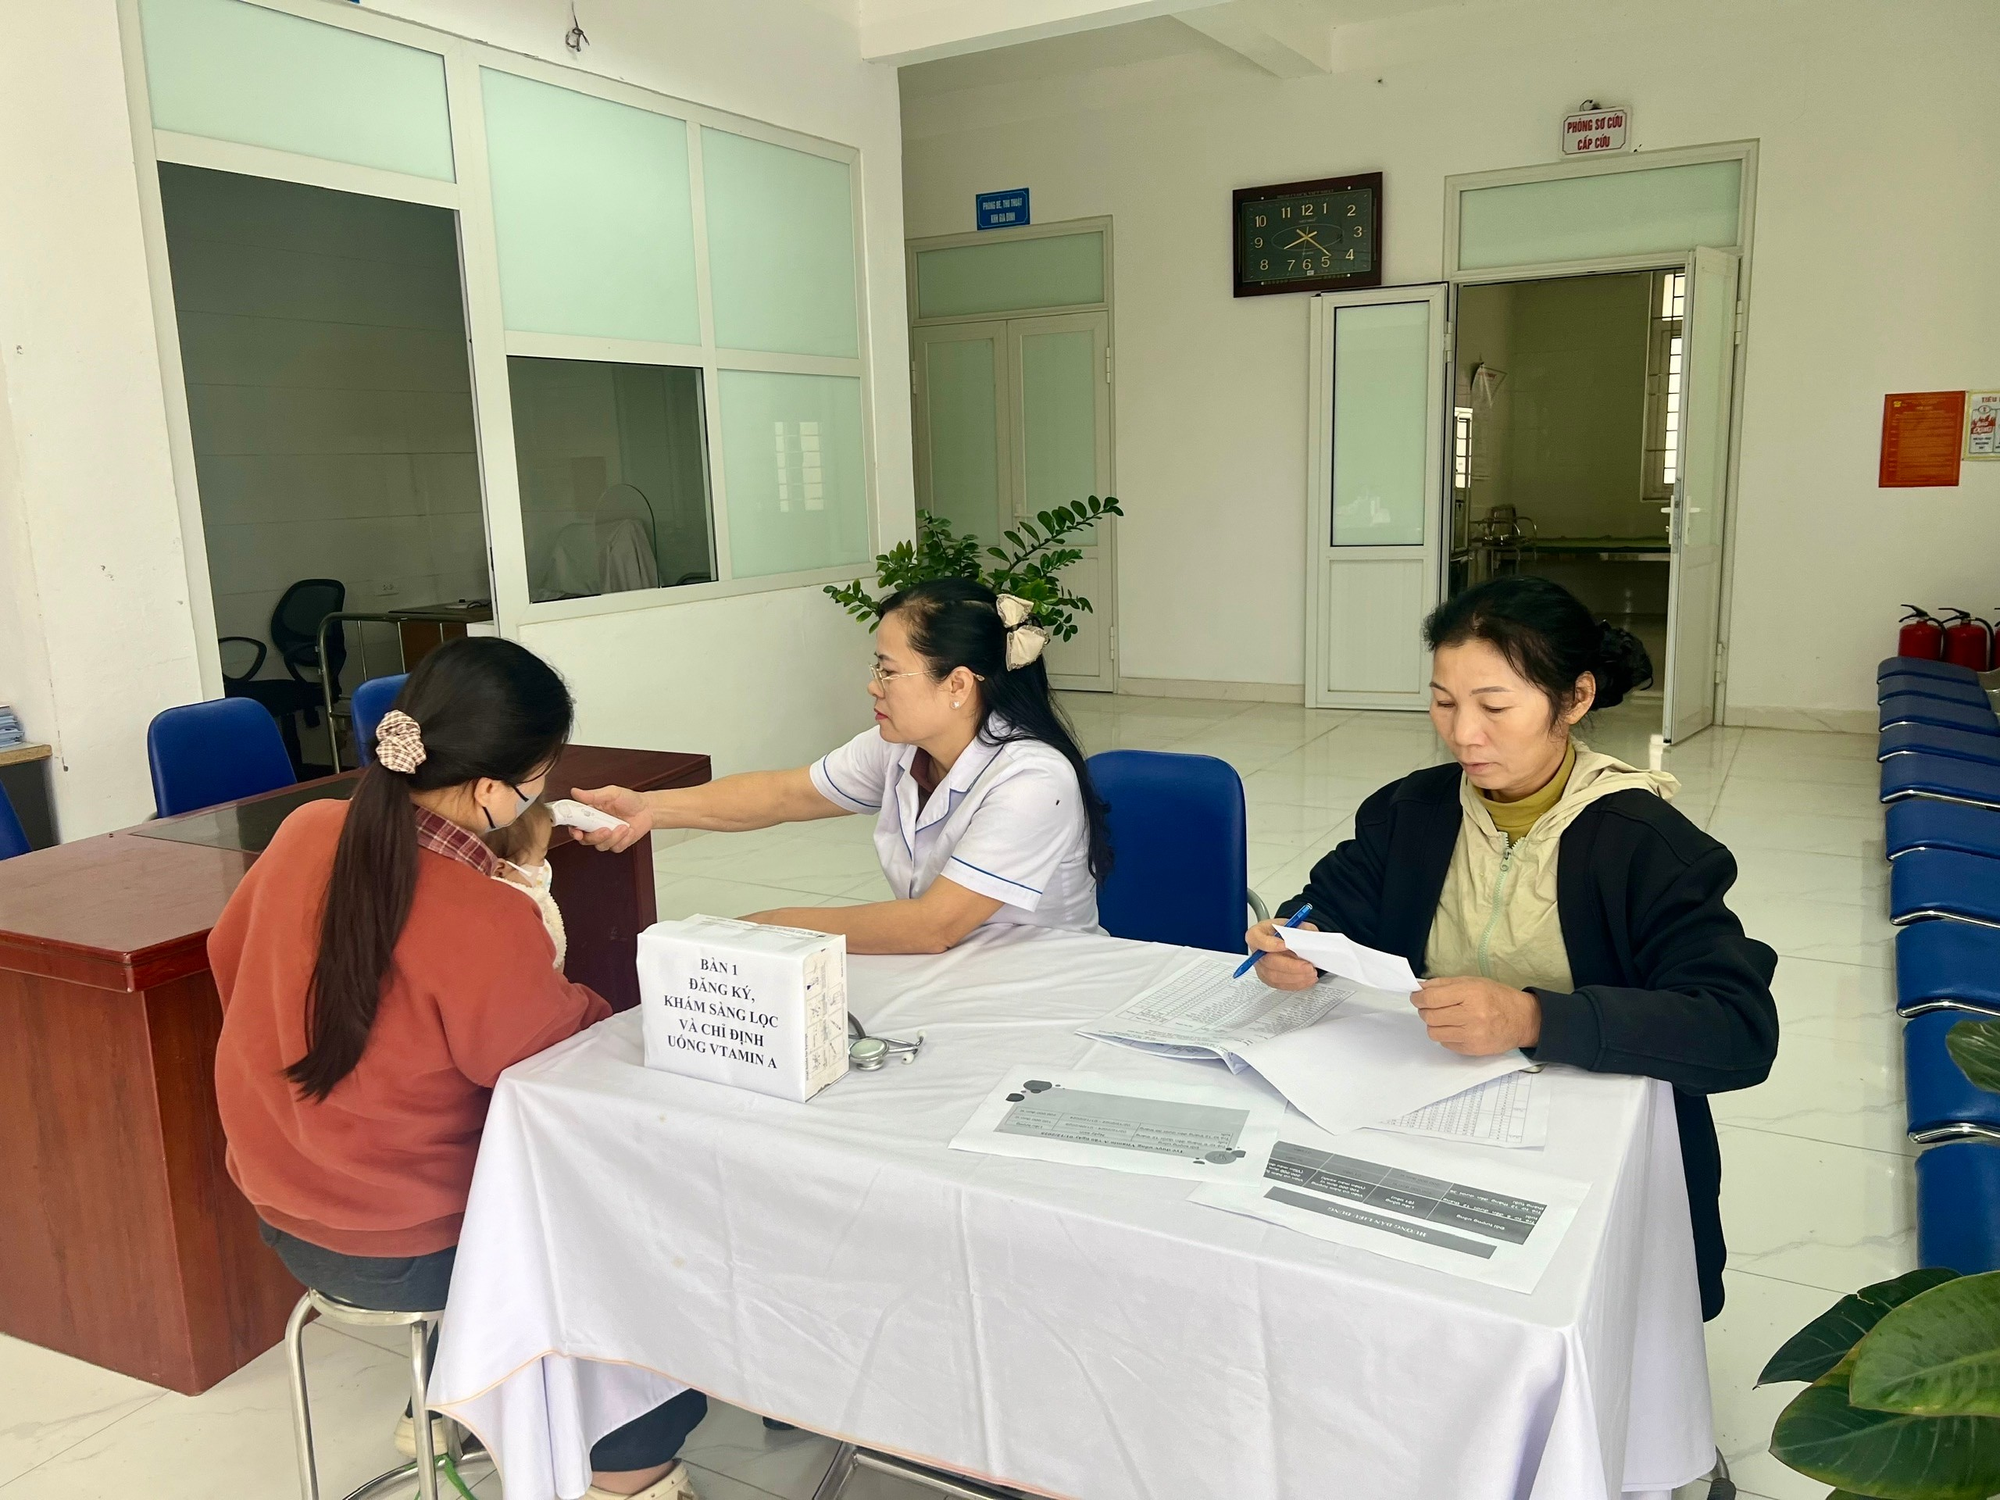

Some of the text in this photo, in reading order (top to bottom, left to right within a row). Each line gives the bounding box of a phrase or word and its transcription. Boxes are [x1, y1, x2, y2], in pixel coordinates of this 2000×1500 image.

[1567, 118, 1592, 133] PHÒNG
[1607, 113, 1623, 129] CỨU
[1578, 134, 1610, 150] CẤP CỨU
[1281, 207, 1291, 218] 11
[1301, 204, 1314, 216] 12
[1322, 202, 1327, 214] 1
[1347, 204, 1356, 217] 2
[1255, 215, 1266, 228] 10
[1354, 226, 1362, 238] 3
[1254, 237, 1263, 248] 9
[1346, 248, 1354, 260] 4
[1260, 259, 1268, 270] 8
[1287, 260, 1296, 271] 7
[1302, 258, 1312, 270] 6
[1322, 256, 1330, 268] 5
[700, 957, 738, 976] BÀN 1
[689, 977, 755, 1002] ĐĂNG KÝ,
[664, 996, 778, 1028] KHÁM SÀNG LỌC
[679, 1018, 764, 1047] VÀ CHỈ ĐỊNH
[668, 1034, 778, 1069] UỐNG VTAMIN A
